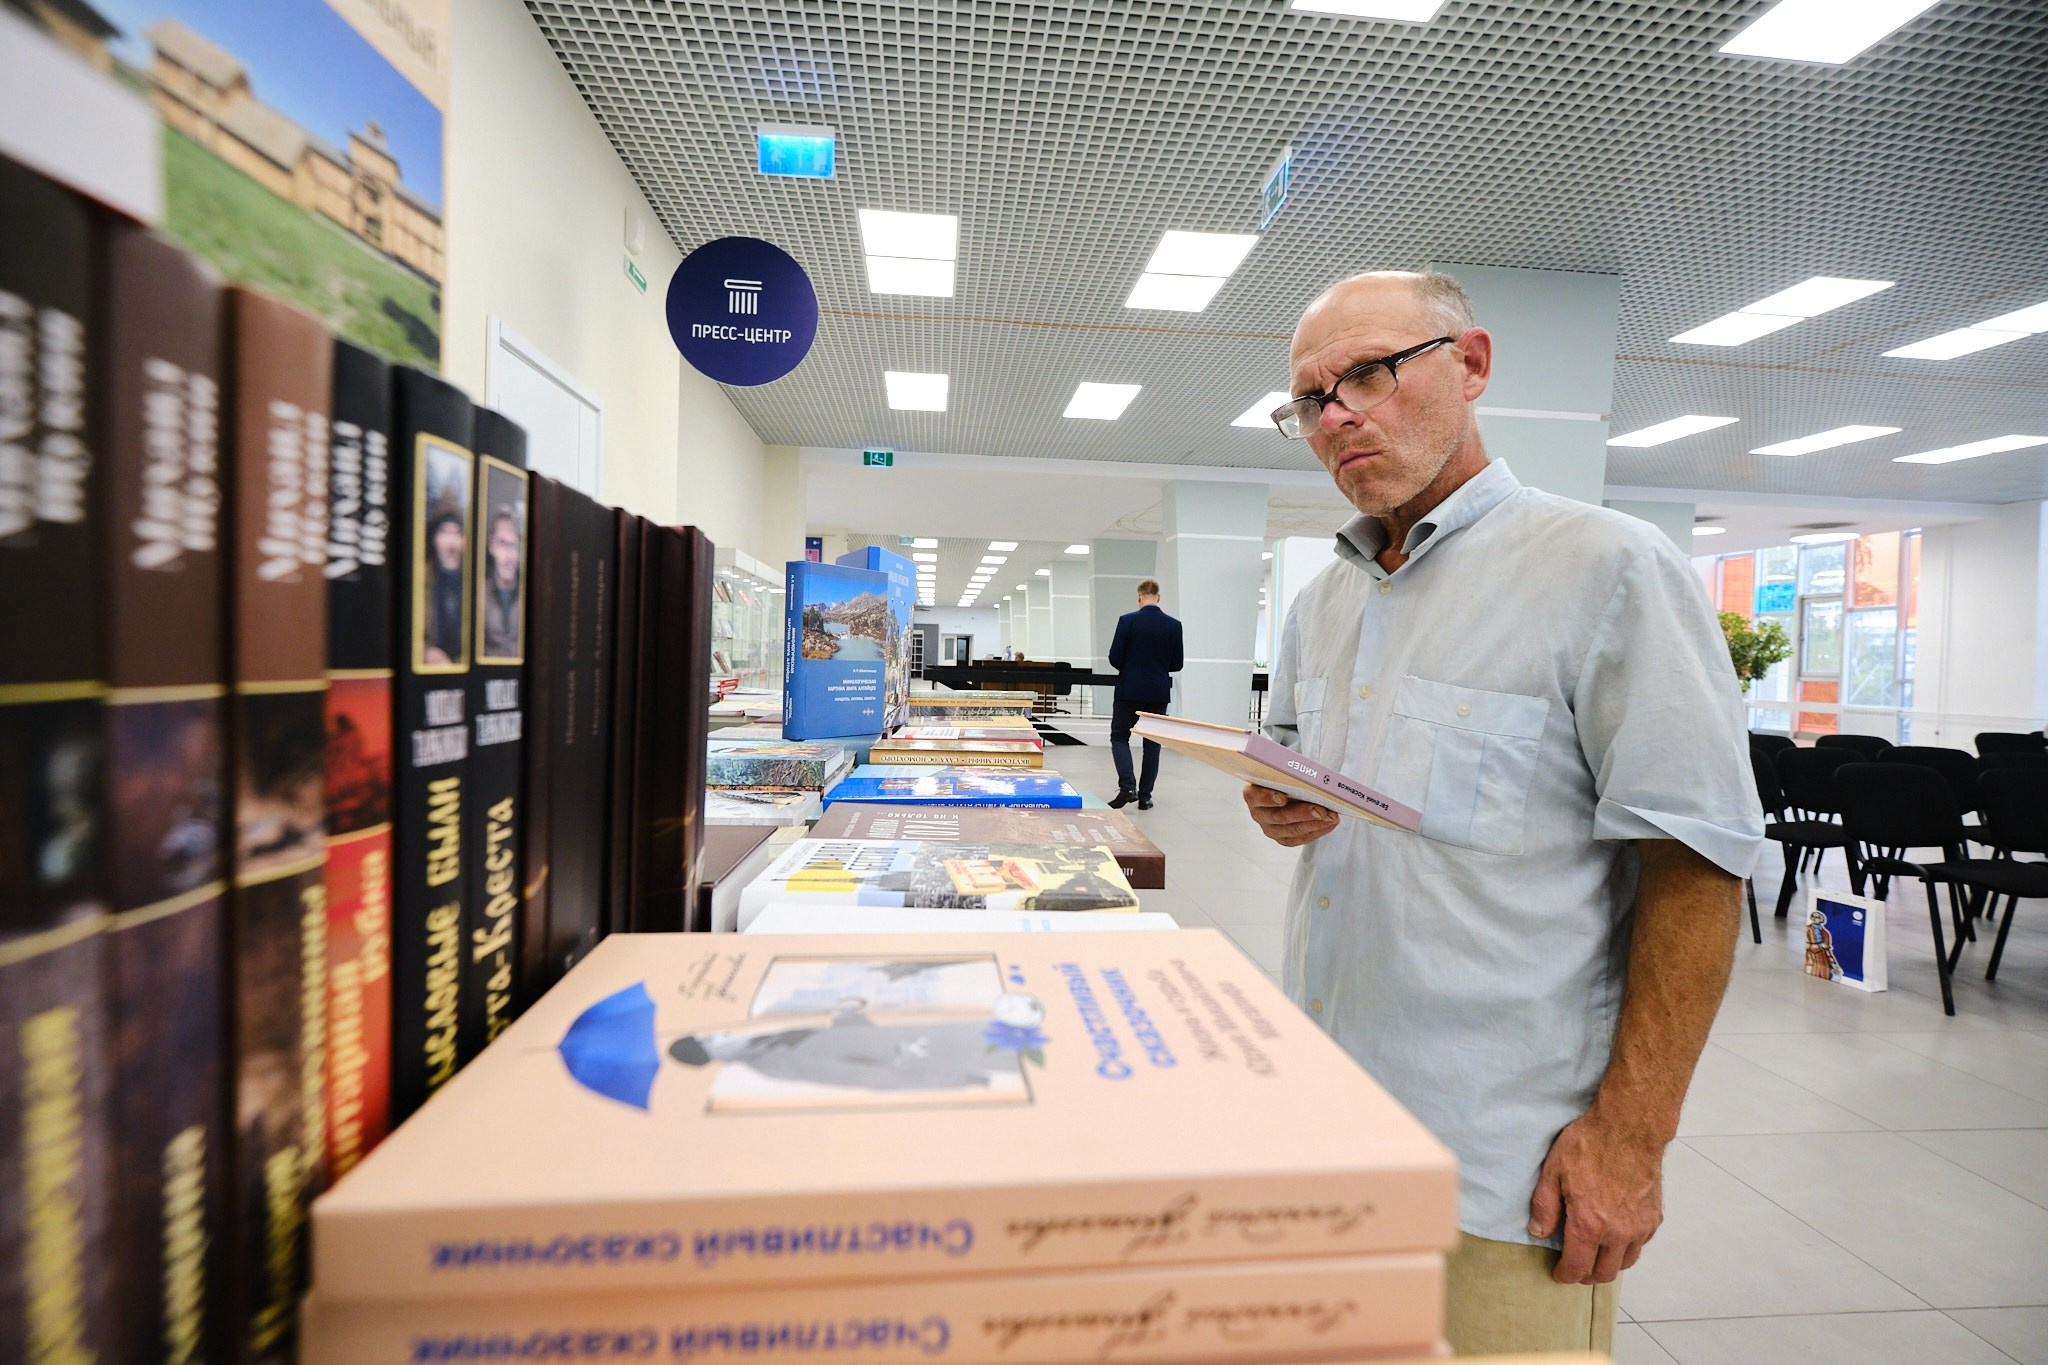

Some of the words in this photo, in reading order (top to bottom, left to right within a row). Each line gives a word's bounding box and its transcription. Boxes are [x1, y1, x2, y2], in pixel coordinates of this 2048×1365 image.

[691, 323, 792, 344] ПРЕСС-ЦЕНТР
[1287, 759, 1318, 779] КИПЕР
[1337, 782, 1365, 800] Косенков
[1366, 796, 1389, 811] Евгений
[432, 1232, 682, 1271] сказочник
[694, 1219, 974, 1270] Счастливый
[412, 1324, 659, 1364] сказочник
[670, 1315, 951, 1364] Счастливый
